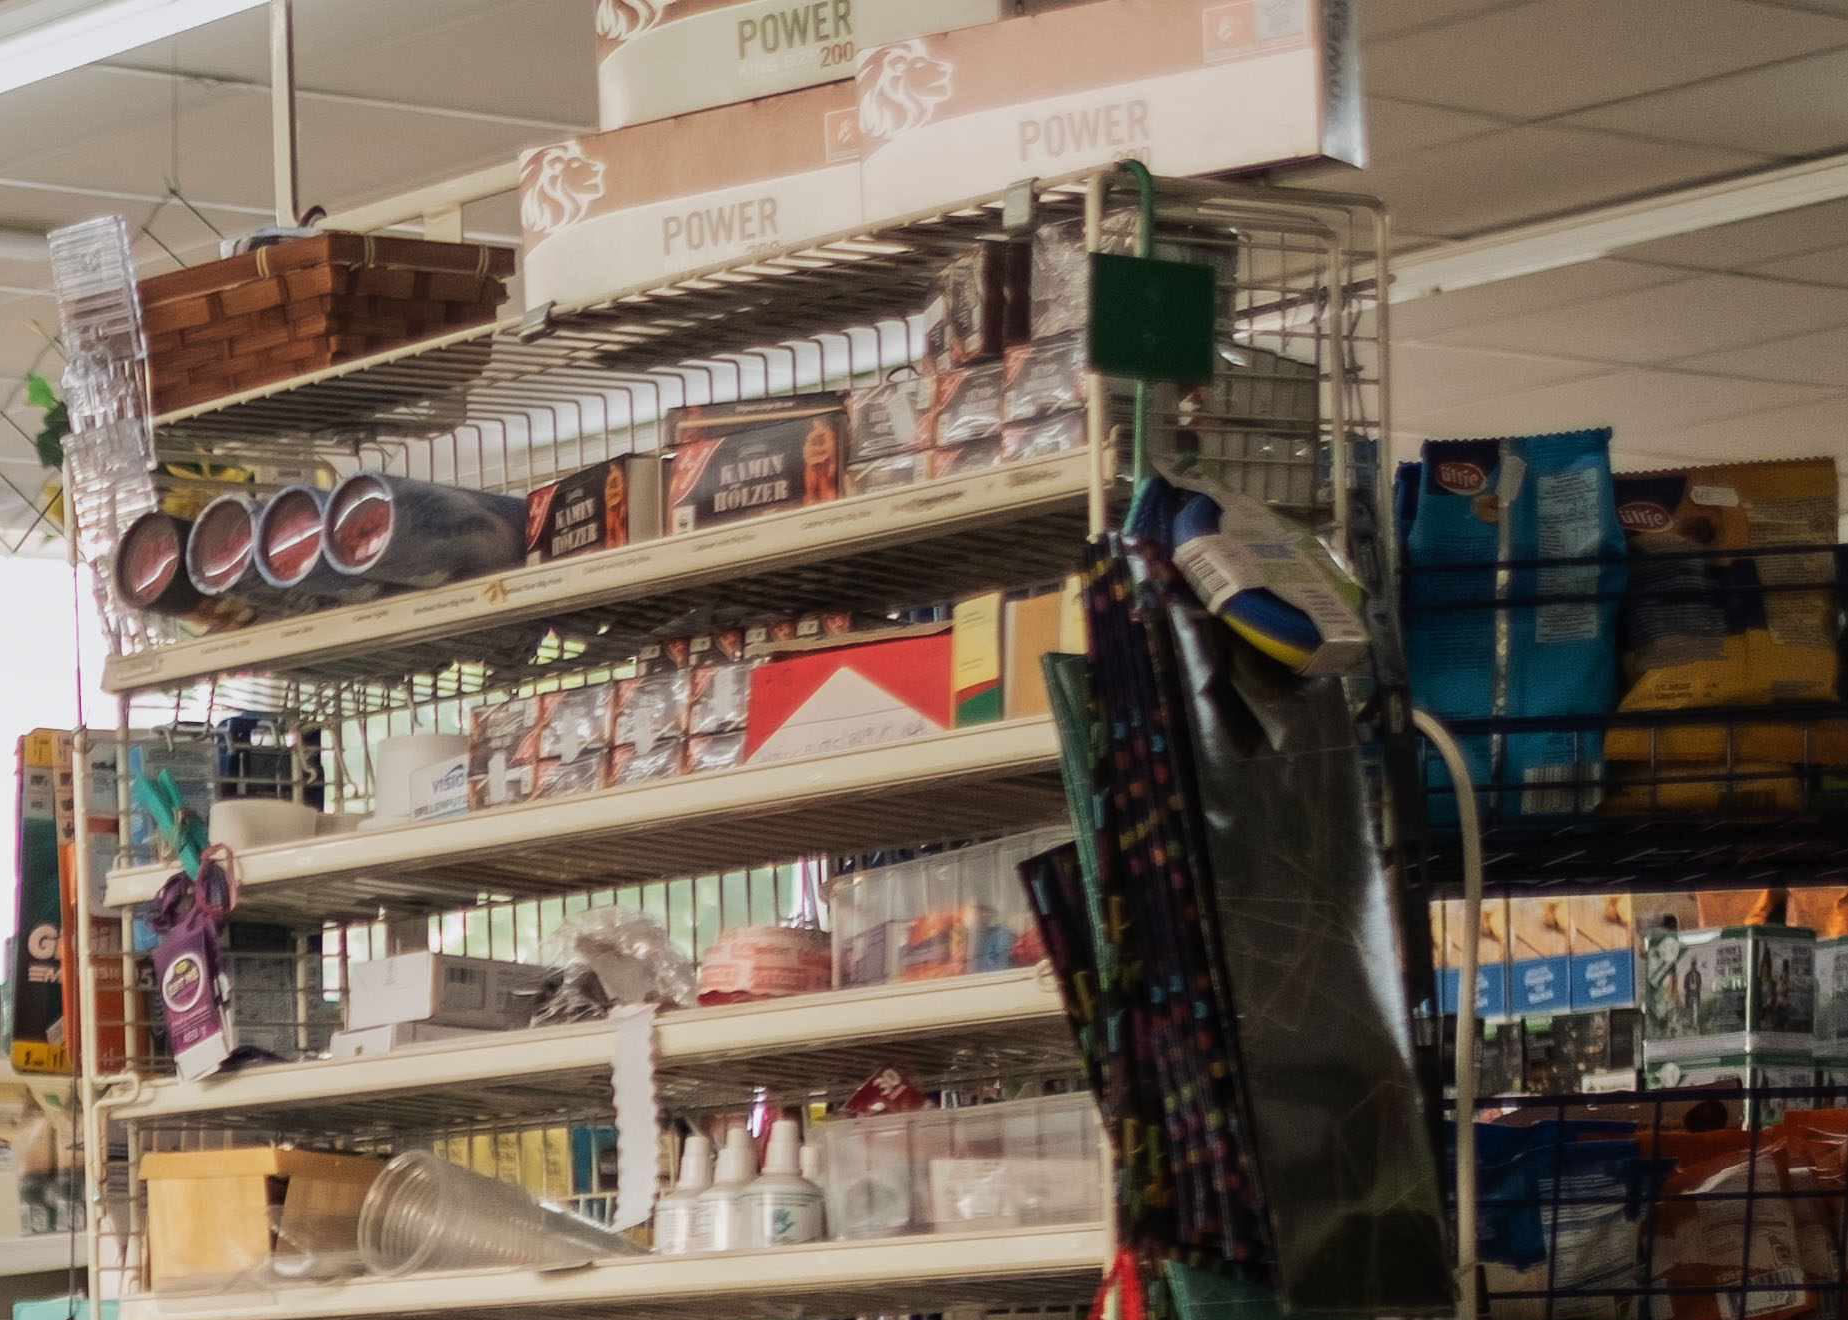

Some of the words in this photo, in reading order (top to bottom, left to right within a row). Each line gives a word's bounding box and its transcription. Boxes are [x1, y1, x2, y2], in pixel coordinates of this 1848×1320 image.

[736, 0, 853, 60] POWER
[818, 42, 855, 69] 200
[1017, 99, 1151, 163] POWER
[662, 195, 779, 256] POWER
[719, 453, 785, 482] KAMIN
[555, 497, 594, 526] KAMIN
[713, 479, 788, 514] HÖLZER
[551, 522, 598, 557] HÖLZER
